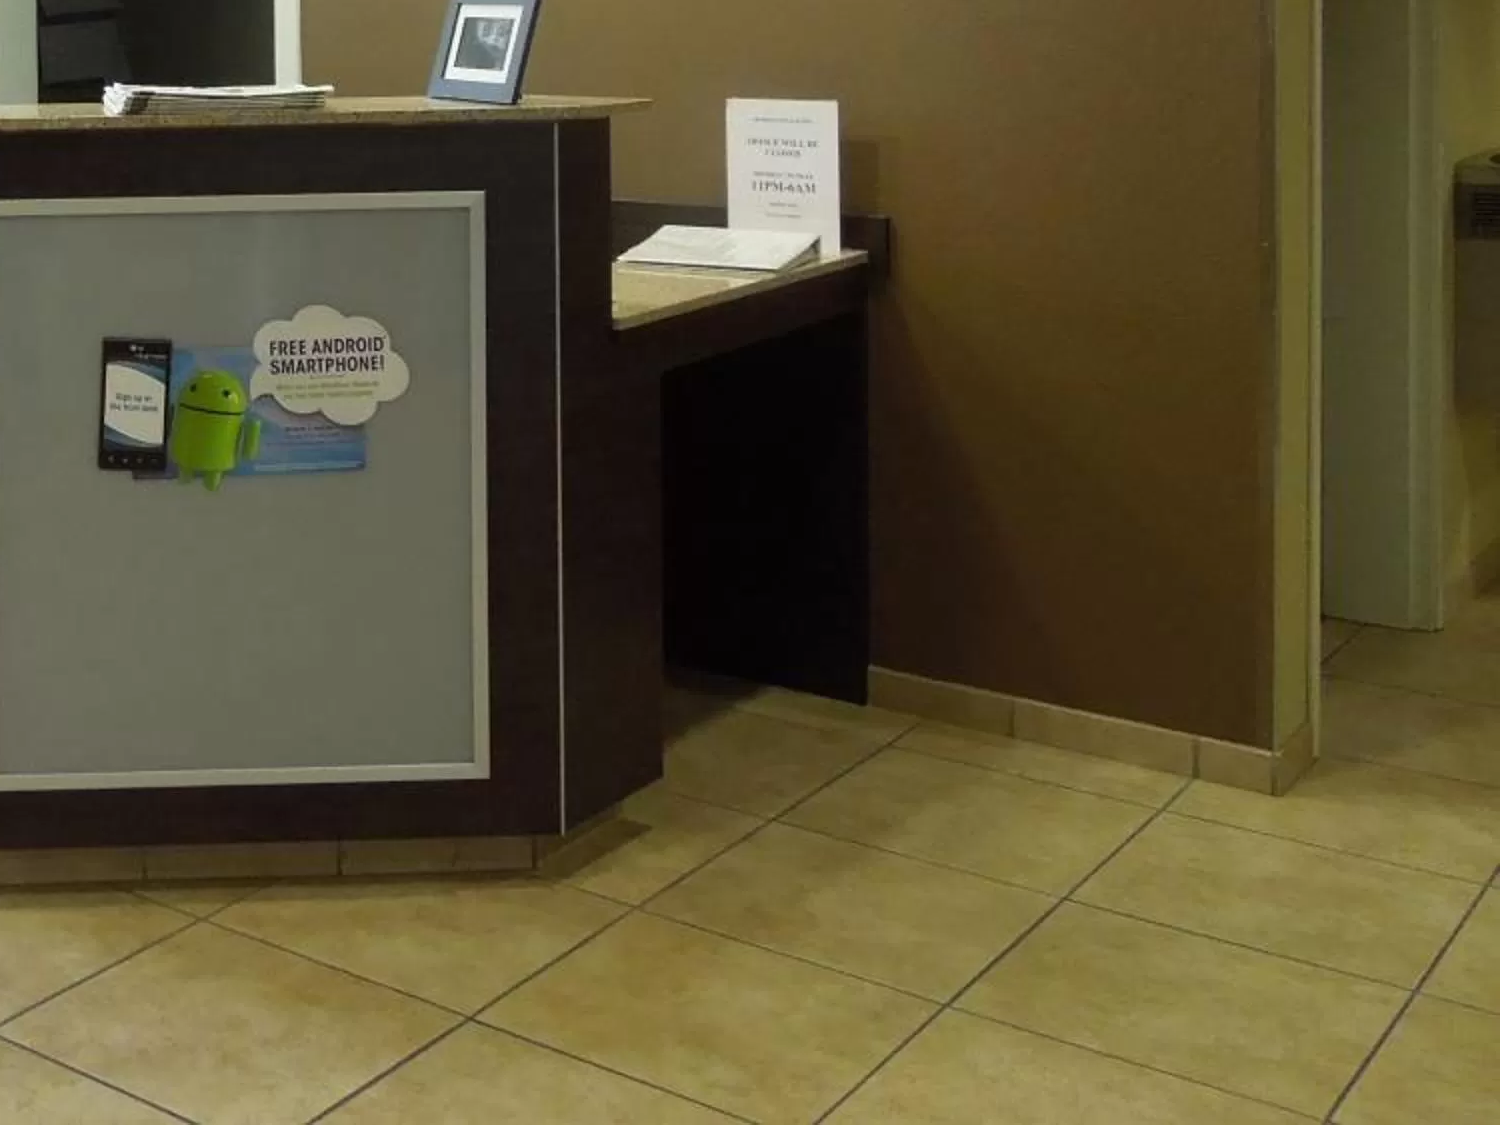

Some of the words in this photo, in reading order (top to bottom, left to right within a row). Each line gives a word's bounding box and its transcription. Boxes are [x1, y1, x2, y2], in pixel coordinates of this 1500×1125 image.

[269, 338, 306, 356] FREE
[312, 336, 385, 355] ANDROID
[269, 355, 385, 375] SMARTPHONE!
